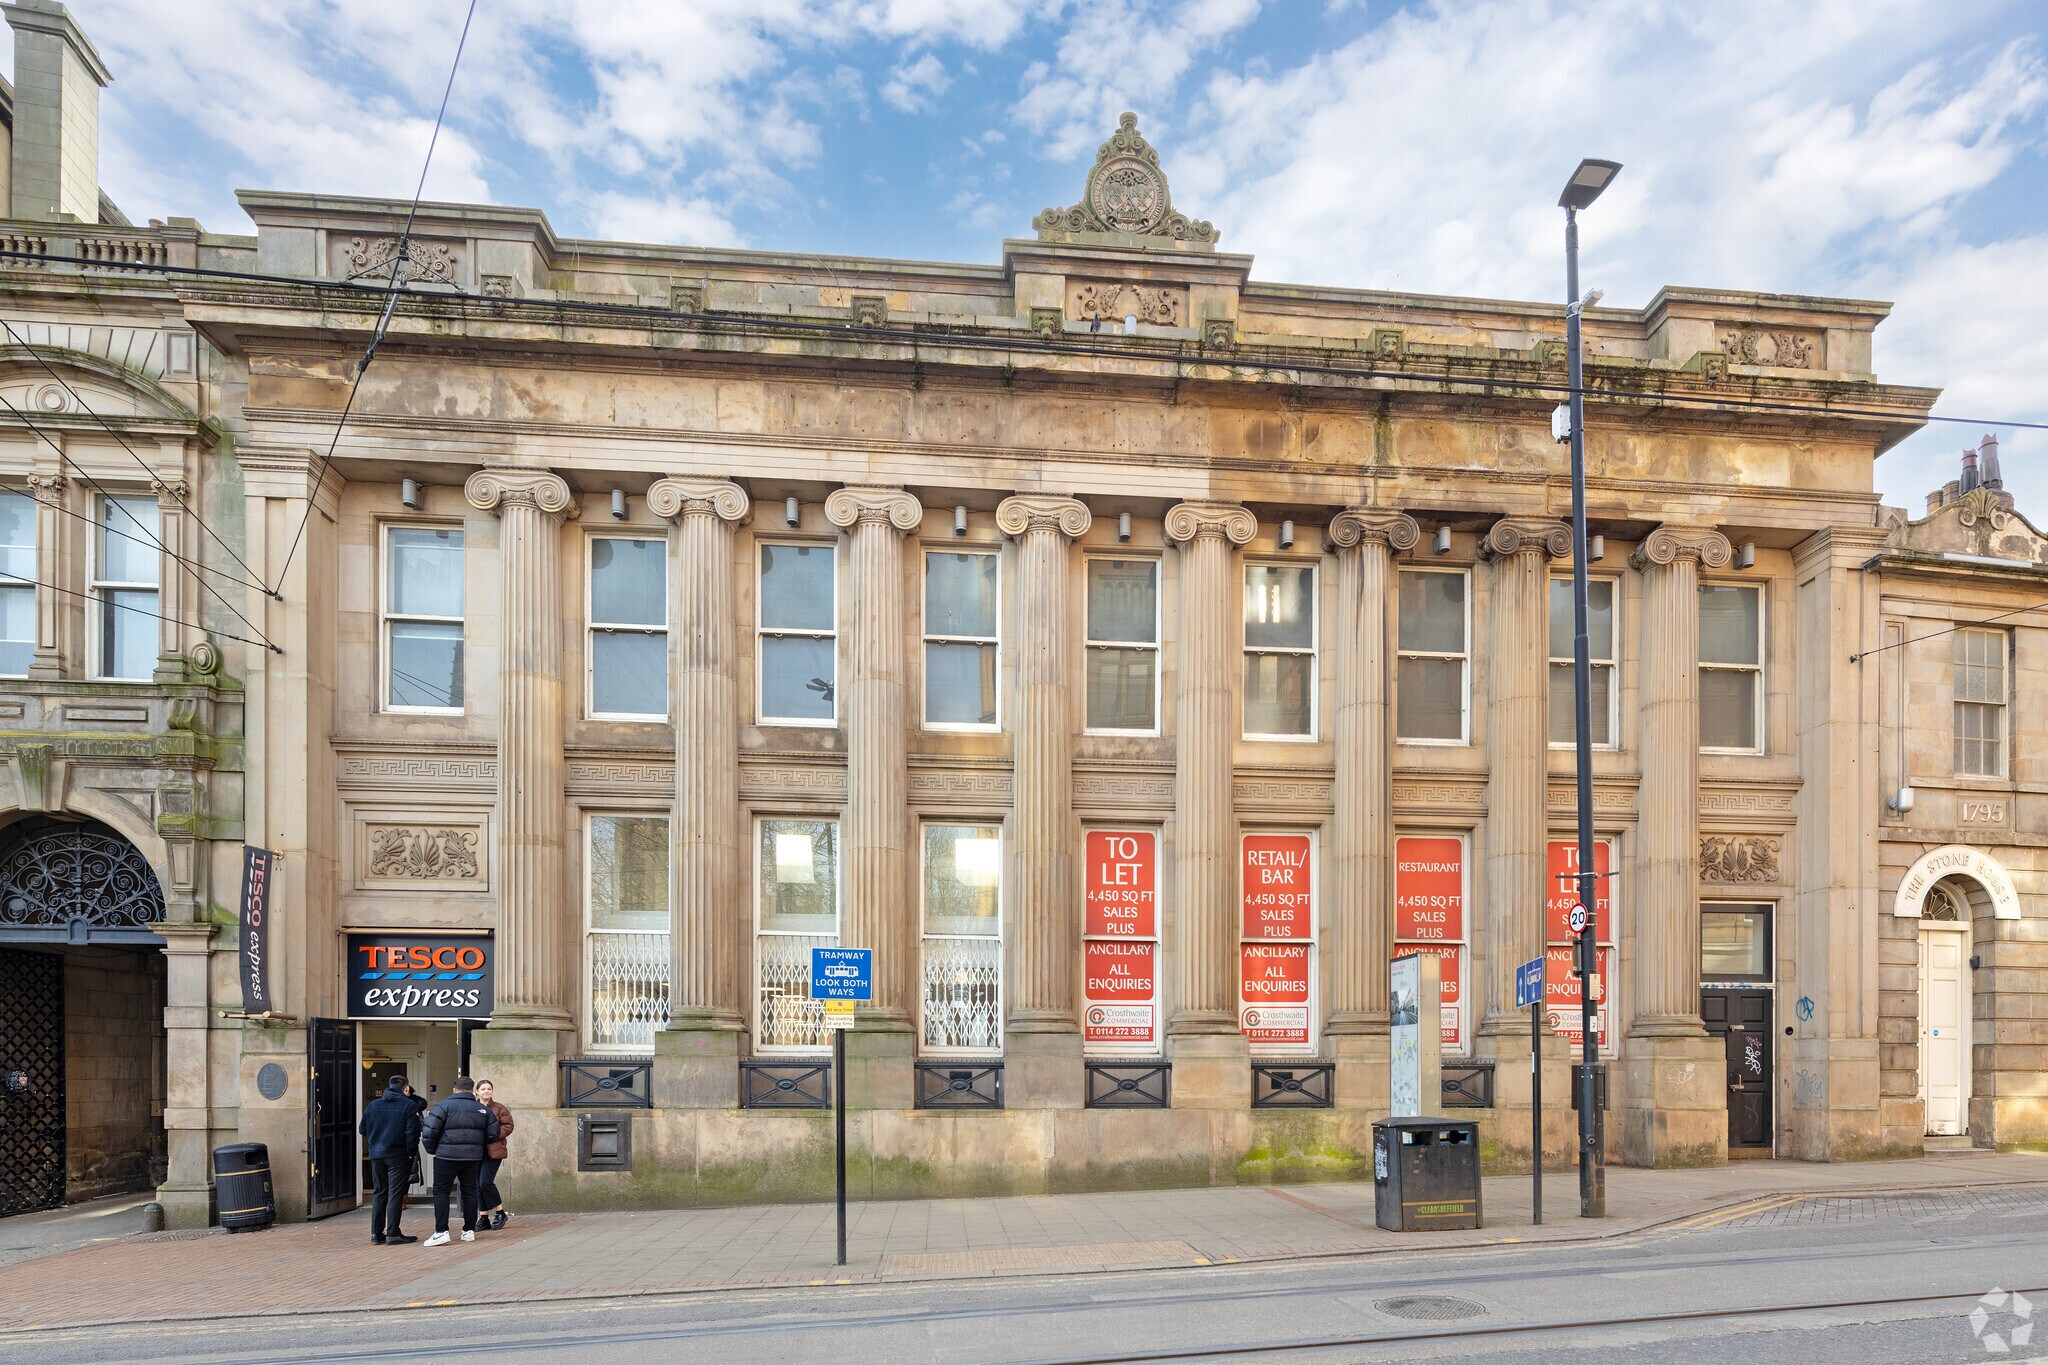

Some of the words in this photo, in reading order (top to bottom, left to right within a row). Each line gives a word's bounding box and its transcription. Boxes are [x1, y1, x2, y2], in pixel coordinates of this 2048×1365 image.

[1962, 803, 2003, 822] 1795
[1105, 837, 1138, 860] TO
[1248, 848, 1307, 868] RETAIL/
[1562, 847, 1579, 868] T
[1398, 862, 1460, 872] RESTAURANT
[1102, 862, 1143, 885] LET
[1261, 869, 1295, 884] BAR
[1905, 873, 1924, 901] THE
[1926, 853, 1970, 874] STONE
[1976, 860, 2010, 904] HOUSE
[1560, 871, 1580, 894] LE
[251, 854, 267, 927] TESCO
[1087, 890, 1119, 902] 4,450
[1121, 890, 1139, 905] SQ
[1141, 891, 1154, 902] FT
[1244, 893, 1275, 906] 4,450
[1278, 893, 1295, 908] SQ
[1297, 894, 1310, 905] FT
[1398, 895, 1428, 908] 4,450
[1430, 895, 1446, 910] SQ
[1449, 896, 1461, 907] FT
[1596, 898, 1609, 909] FT
[1103, 906, 1138, 918] SALES
[1260, 909, 1295, 921] SALES
[1413, 911, 1446, 923] SALES
[1571, 911, 1585, 925] 20
[1107, 922, 1135, 934] PLUS
[1264, 926, 1291, 937] PLUS
[1416, 927, 1443, 938] PLUS
[819, 951, 865, 960] TRAMWAY
[1088, 944, 1151, 955] ANCILLARY
[1244, 946, 1306, 958] ANCILLARY
[359, 945, 485, 970] TESCO
[248, 930, 263, 1001] express
[1109, 963, 1131, 975] ALL
[1264, 966, 1286, 978] ALL
[815, 979, 840, 987] LOOK
[843, 979, 868, 988] BOTH
[1088, 977, 1152, 993] ENQUIRIES
[1245, 980, 1306, 995] ENQUIRIES
[828, 988, 855, 996] WAYS
[364, 984, 480, 1015] express
[1106, 1008, 1150, 1017] Crosthwaite
[1262, 1011, 1305, 1019] Crosthwaite
[1089, 1027, 1095, 1035] T
[1096, 1027, 1114, 1035] 0114
[1130, 1028, 1150, 1036] 3888
[1252, 1029, 1269, 1037] 0114
[1271, 1029, 1285, 1037] 272
[1286, 1029, 1305, 1037] 3888
[1441, 1029, 1455, 1037] 888
[1570, 1031, 1583, 1039] 272
